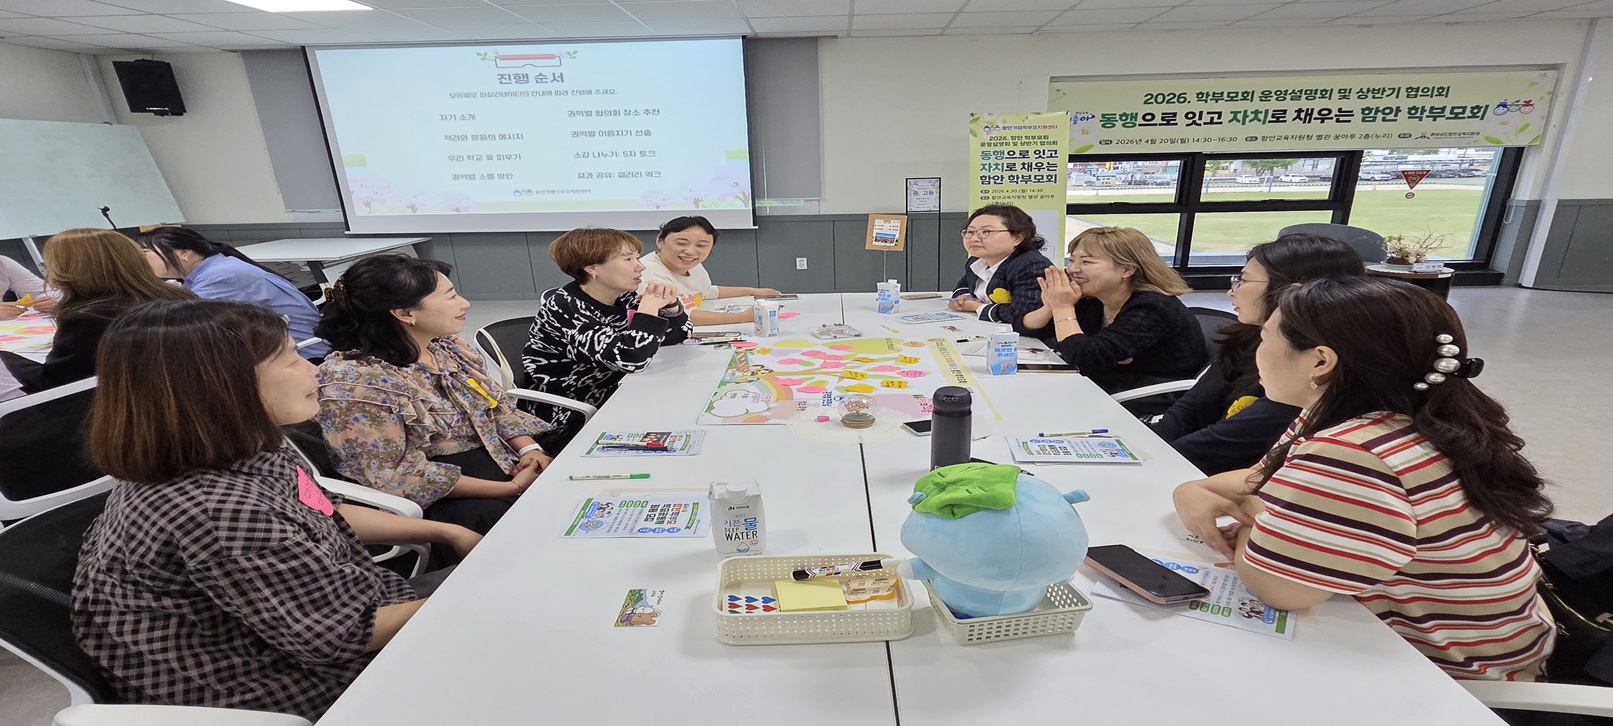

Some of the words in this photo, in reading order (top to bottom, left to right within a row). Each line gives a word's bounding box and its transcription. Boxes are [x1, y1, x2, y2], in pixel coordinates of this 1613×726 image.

[497, 72, 530, 84] 진행
[534, 72, 564, 84] 순서
[1143, 92, 1192, 104] 2026.
[1195, 90, 1255, 104] 학부모회
[1258, 88, 1334, 102] 운영설명회
[1338, 88, 1352, 100] 및
[1355, 86, 1402, 100] 상반기
[1405, 86, 1450, 98] 협의회
[1099, 112, 1178, 129] 동행으로
[1184, 110, 1224, 126] 잇고
[1228, 108, 1288, 126] 자치로
[1292, 107, 1355, 124] 채우는
[1360, 106, 1402, 122] 함안
[1406, 104, 1490, 122] 학부모회
[980, 150, 1030, 160] 동행으로
[1033, 149, 1058, 159] 잇고
[980, 162, 1018, 172] 자치로
[1020, 162, 1058, 172] 채우는
[980, 174, 1005, 185] 함안
[1007, 174, 1057, 184] 학부모회
[742, 517, 758, 530] 물
[725, 530, 758, 541] WATER
